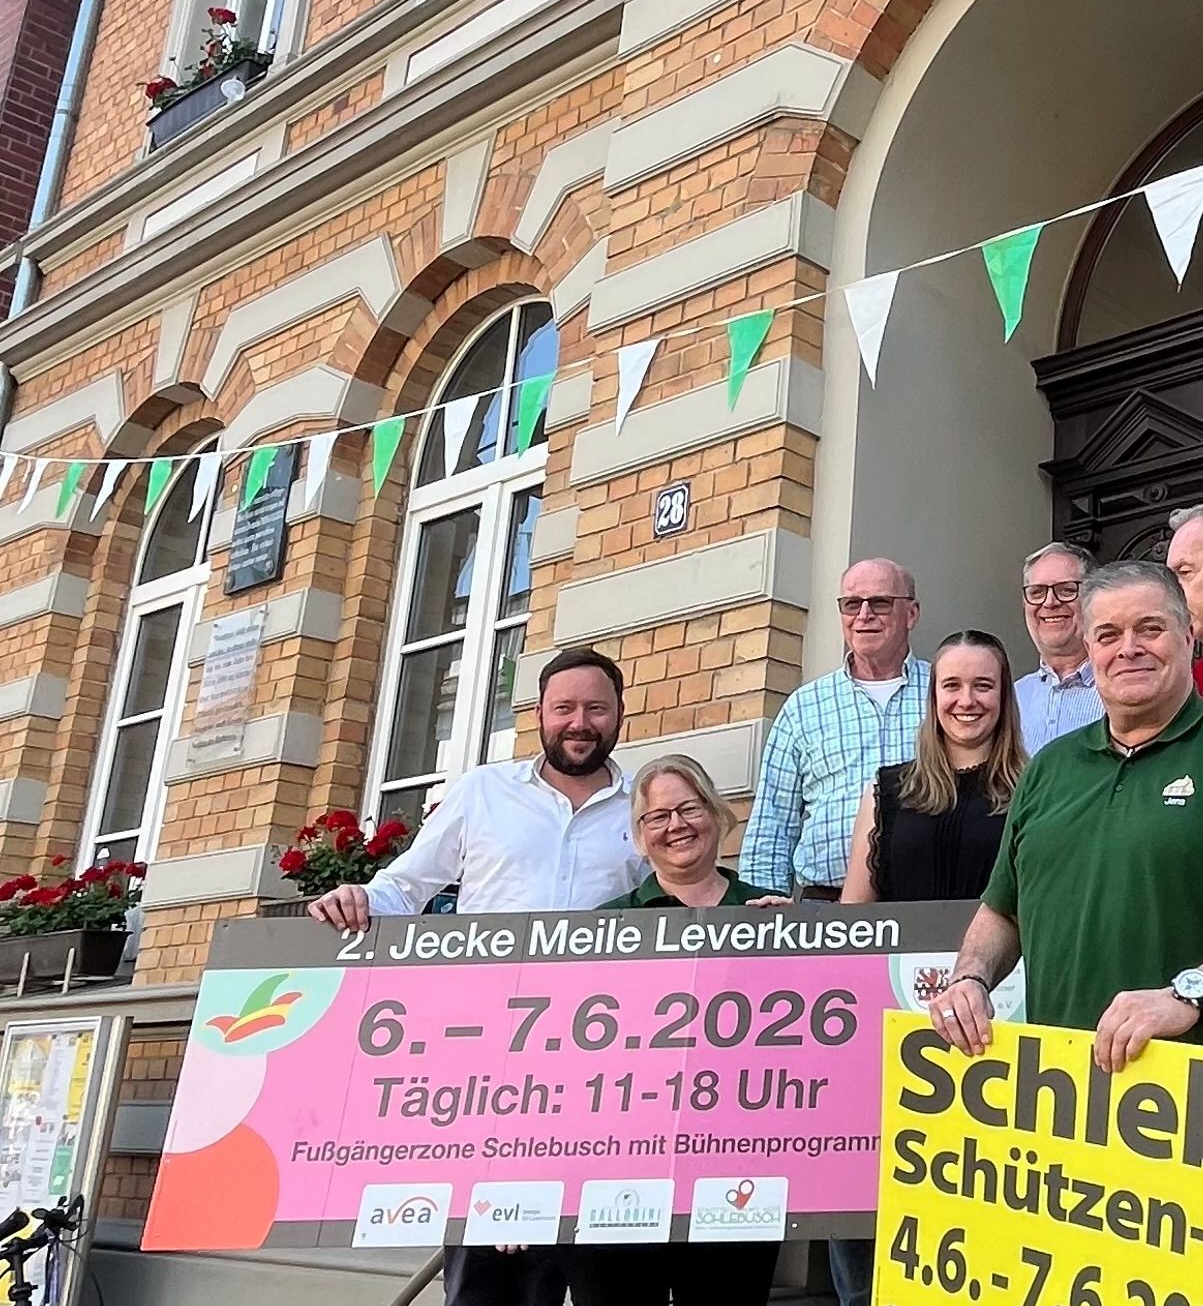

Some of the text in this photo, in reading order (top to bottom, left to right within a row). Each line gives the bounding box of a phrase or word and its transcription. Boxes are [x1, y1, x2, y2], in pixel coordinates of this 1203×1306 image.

[657, 491, 684, 529] 28
[336, 913, 900, 961] 2. Jecke Meile Leverkusen
[358, 999, 426, 1057] 6.
[506, 988, 858, 1054] 7.6.2026
[373, 1068, 829, 1128] Täglich: 11-18 Uhr
[291, 1139, 475, 1167] Fußgängerzone
[481, 1134, 620, 1160] Schlebusch
[628, 1133, 667, 1157] mit
[370, 1203, 434, 1225] avea
[492, 1203, 520, 1223] evl
